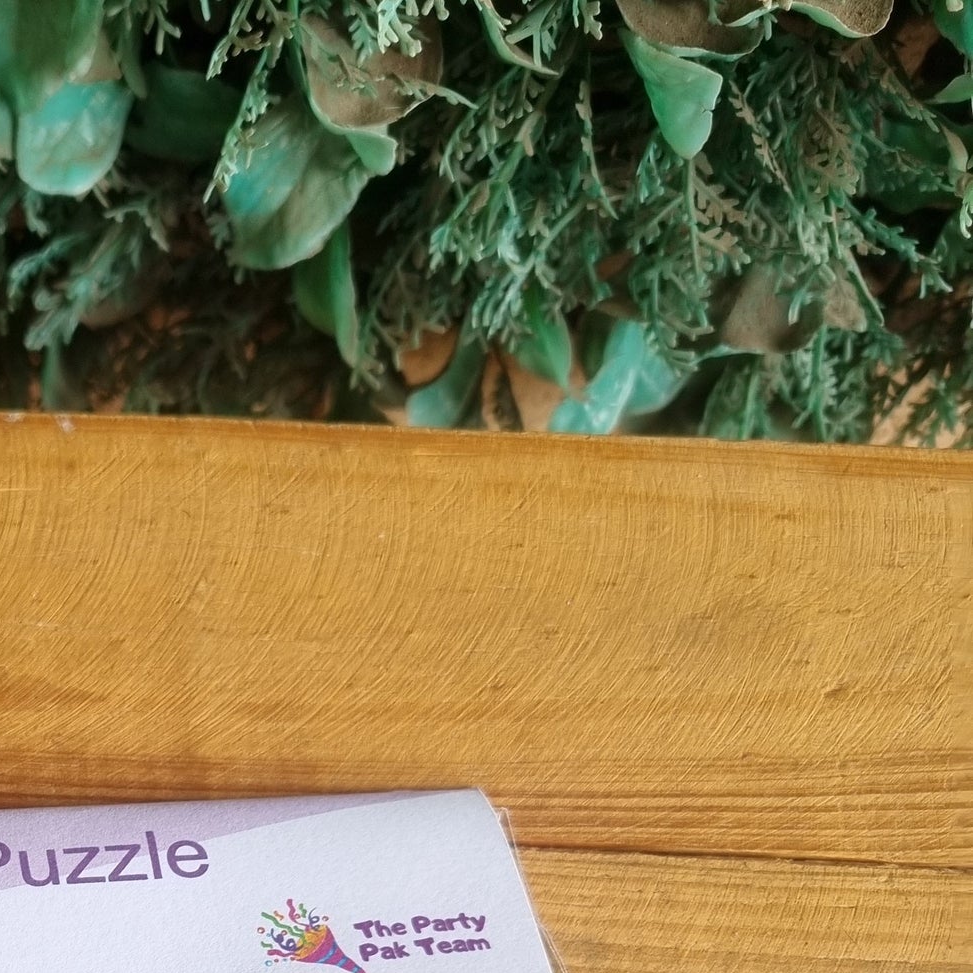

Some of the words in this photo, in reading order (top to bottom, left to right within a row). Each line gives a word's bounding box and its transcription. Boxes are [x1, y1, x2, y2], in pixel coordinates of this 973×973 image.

[353, 919, 408, 939] The
[410, 912, 487, 933] Party
[358, 941, 411, 962] Pak
[413, 936, 492, 956] Team
